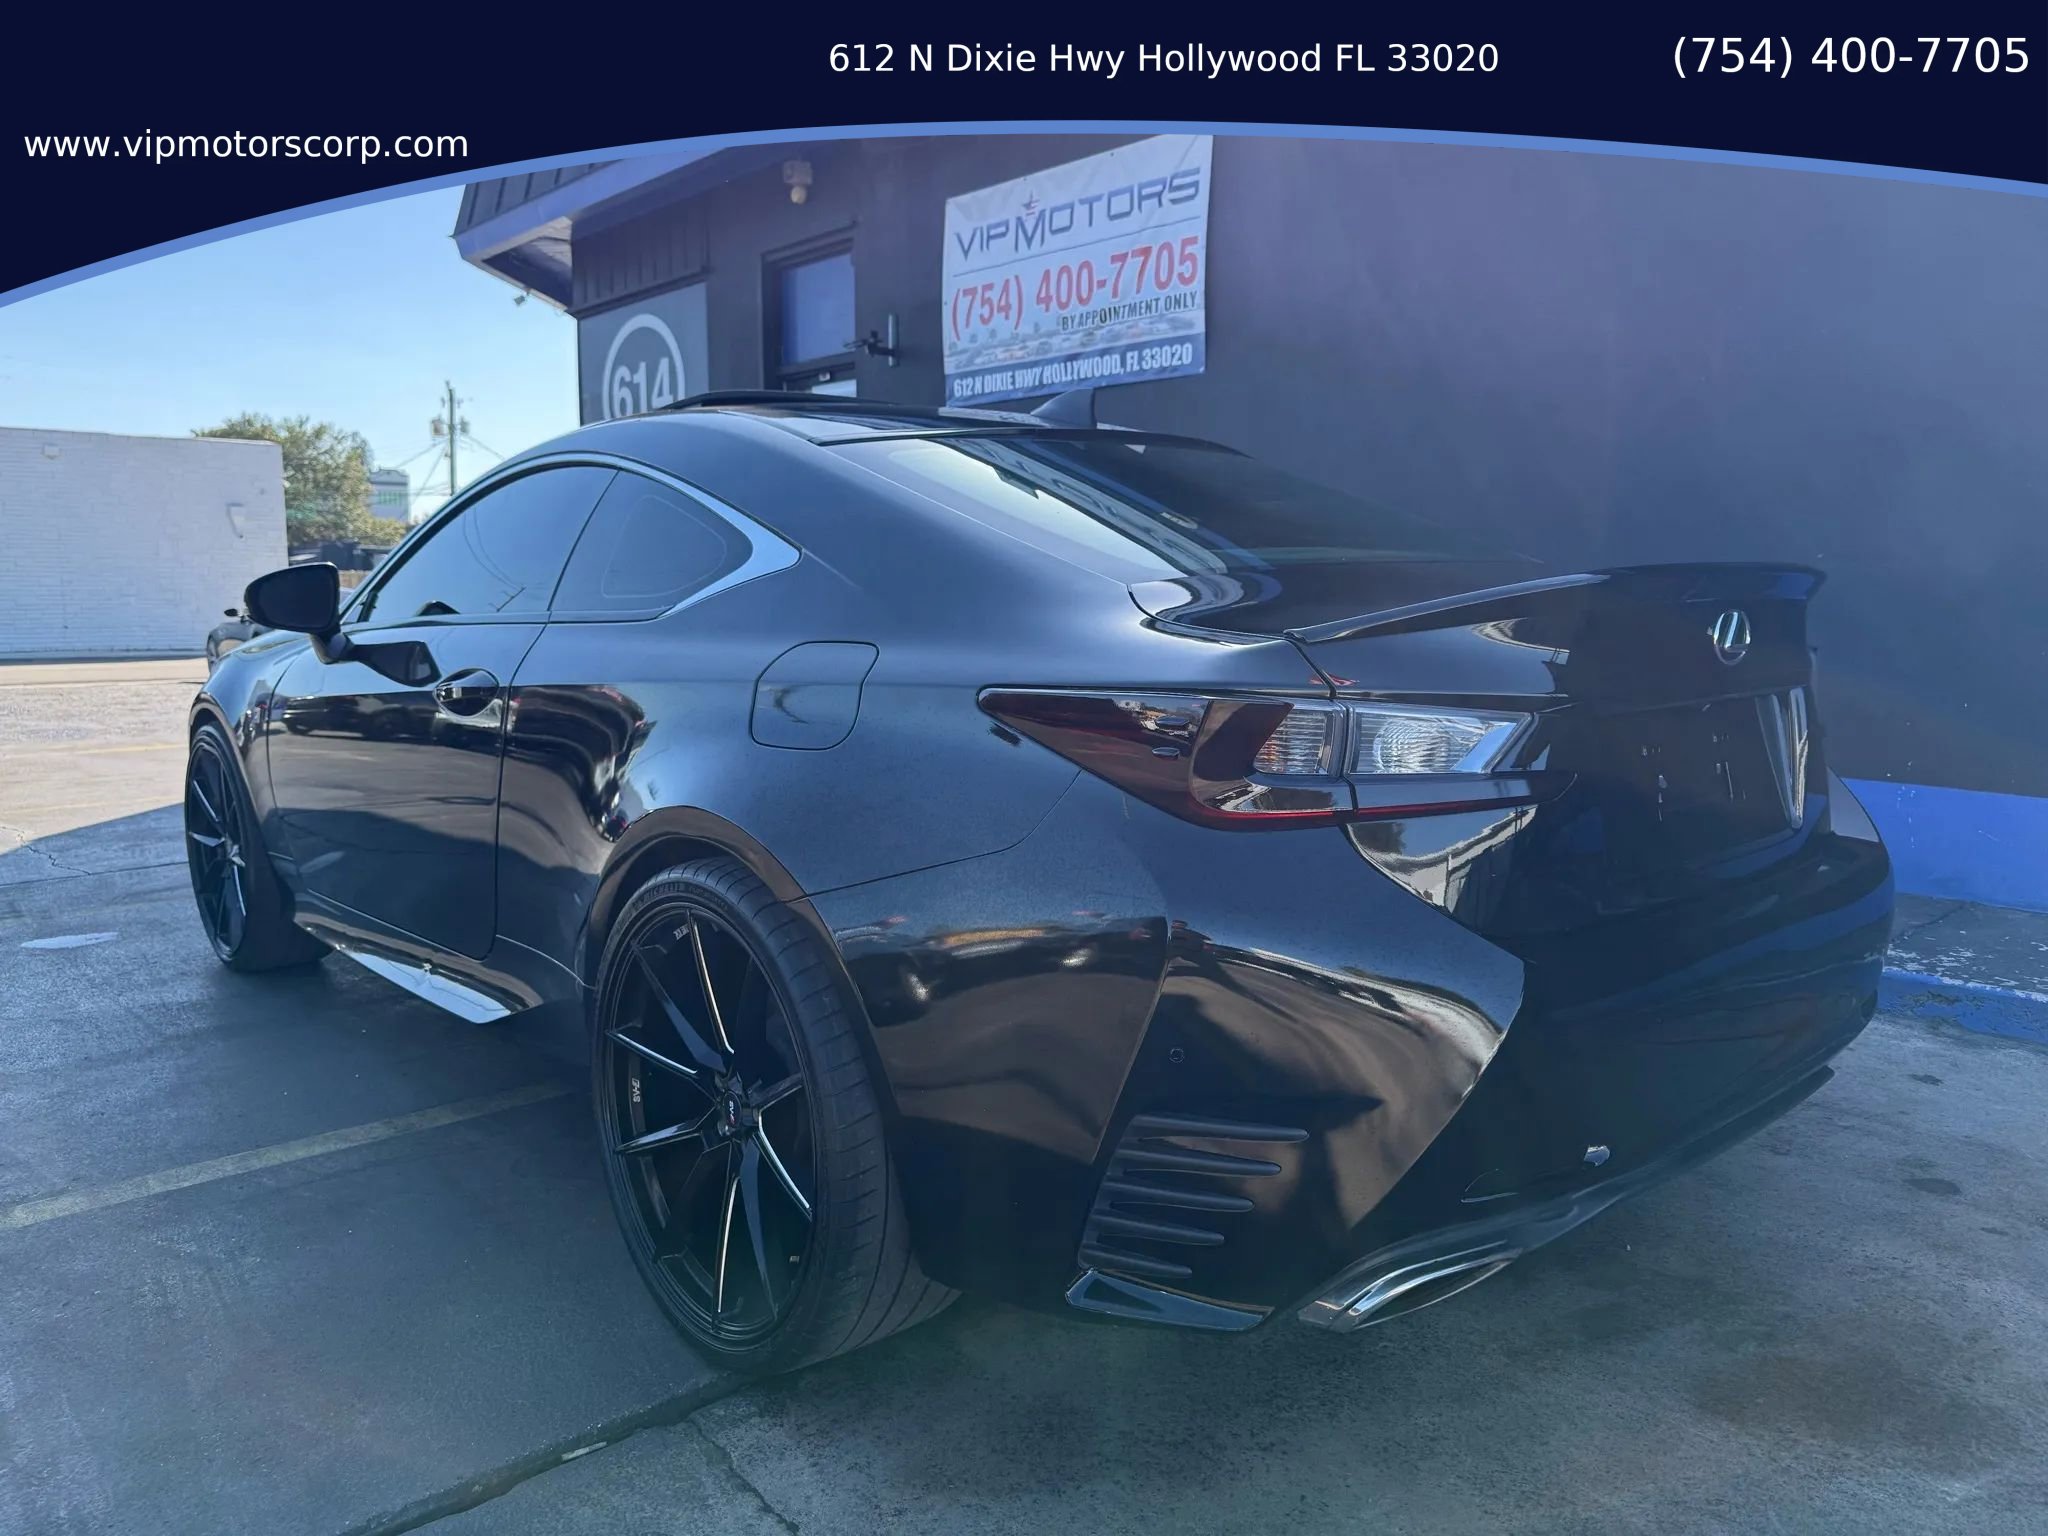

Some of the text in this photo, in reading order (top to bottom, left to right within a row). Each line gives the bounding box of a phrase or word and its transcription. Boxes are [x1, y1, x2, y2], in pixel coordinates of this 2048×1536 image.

[954, 167, 1200, 261] VIP MOTORS
[952, 236, 1199, 341] (754) 400-7705
[1062, 291, 1198, 330] BY APPOINTMENT ONLY
[612, 356, 673, 419] 614
[953, 376, 974, 397] 612
[984, 371, 1014, 393] DIXIE
[1042, 352, 1124, 385] HOLLYWOOD,
[1126, 352, 1140, 372] FL
[1142, 342, 1193, 370] 33020
